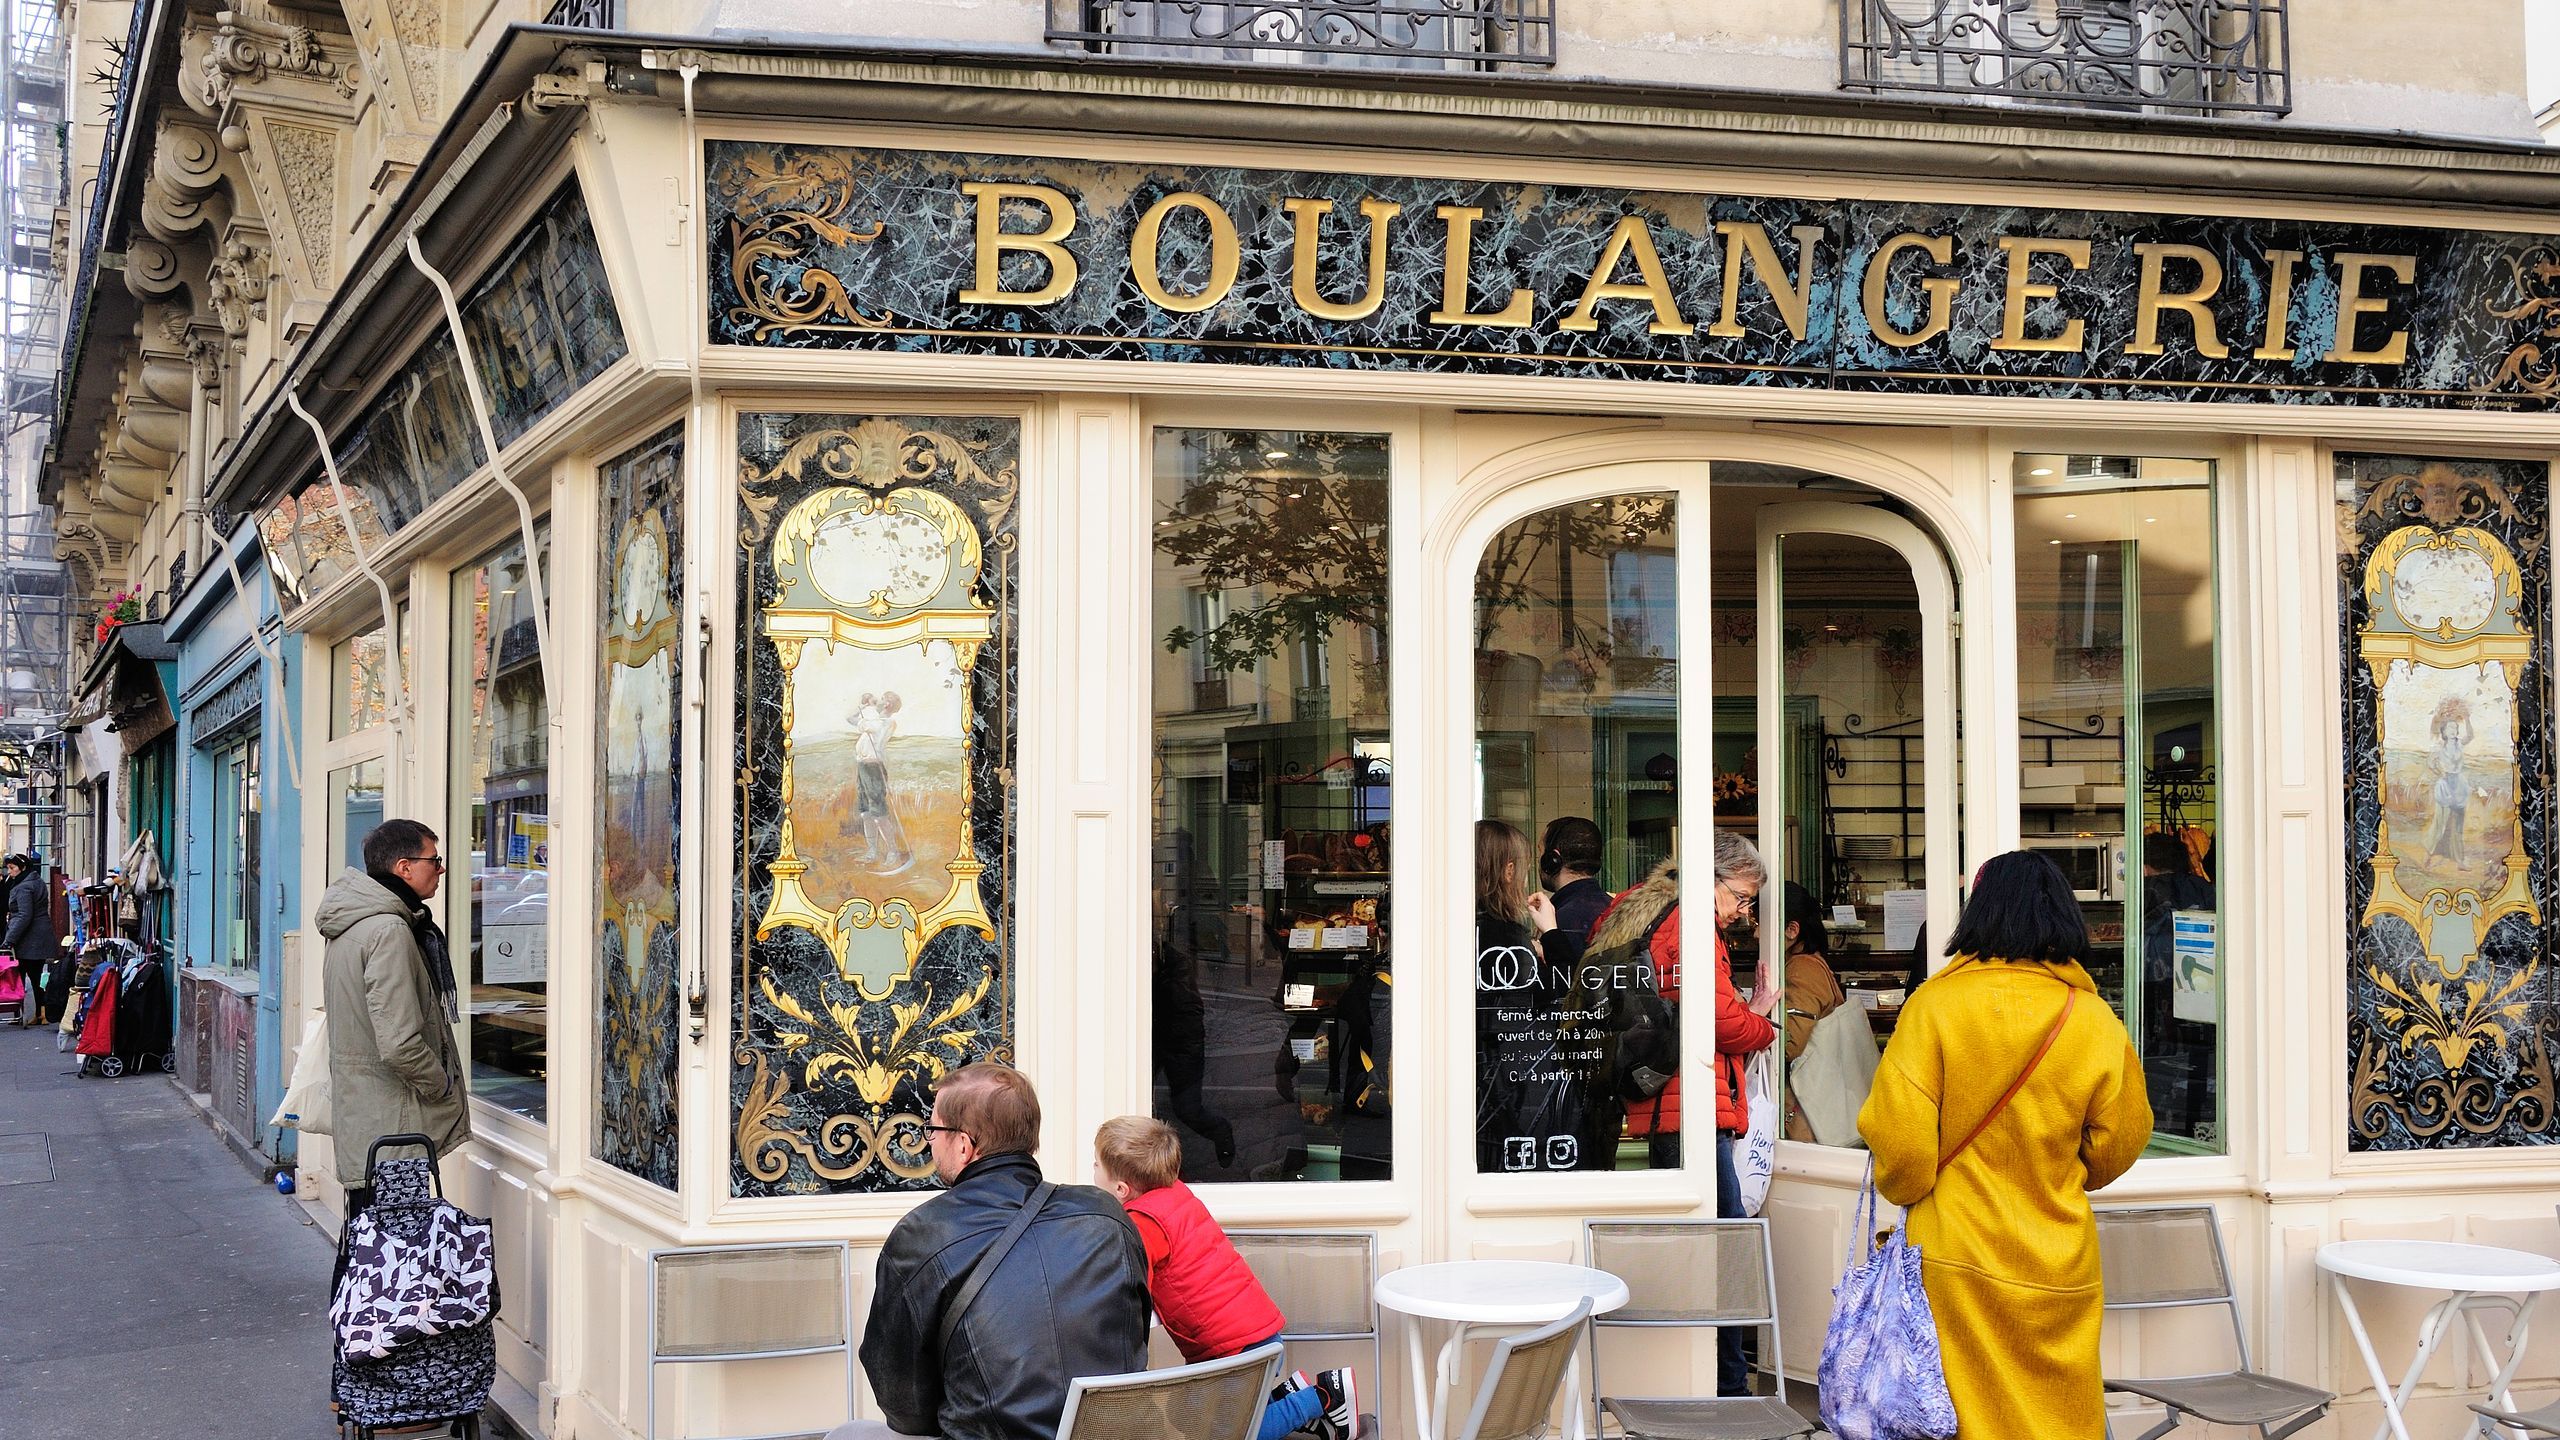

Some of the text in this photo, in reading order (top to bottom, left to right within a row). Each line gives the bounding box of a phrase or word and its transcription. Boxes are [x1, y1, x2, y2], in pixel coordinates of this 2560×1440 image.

[960, 181, 2417, 365] BOULANGERIE
[1497, 1008, 1533, 1021] fermé
[1551, 1007, 1604, 1020] mercredi
[1497, 1029, 1535, 1042] ouvert
[1538, 1029, 1552, 1041] de
[1556, 1029, 1570, 1040] 7h
[1573, 1028, 1581, 1040] à
[1551, 1051, 1564, 1061] au
[1568, 1047, 1603, 1060] mardi
[1530, 1068, 1538, 1082] à
[1541, 1068, 1575, 1084] partir
